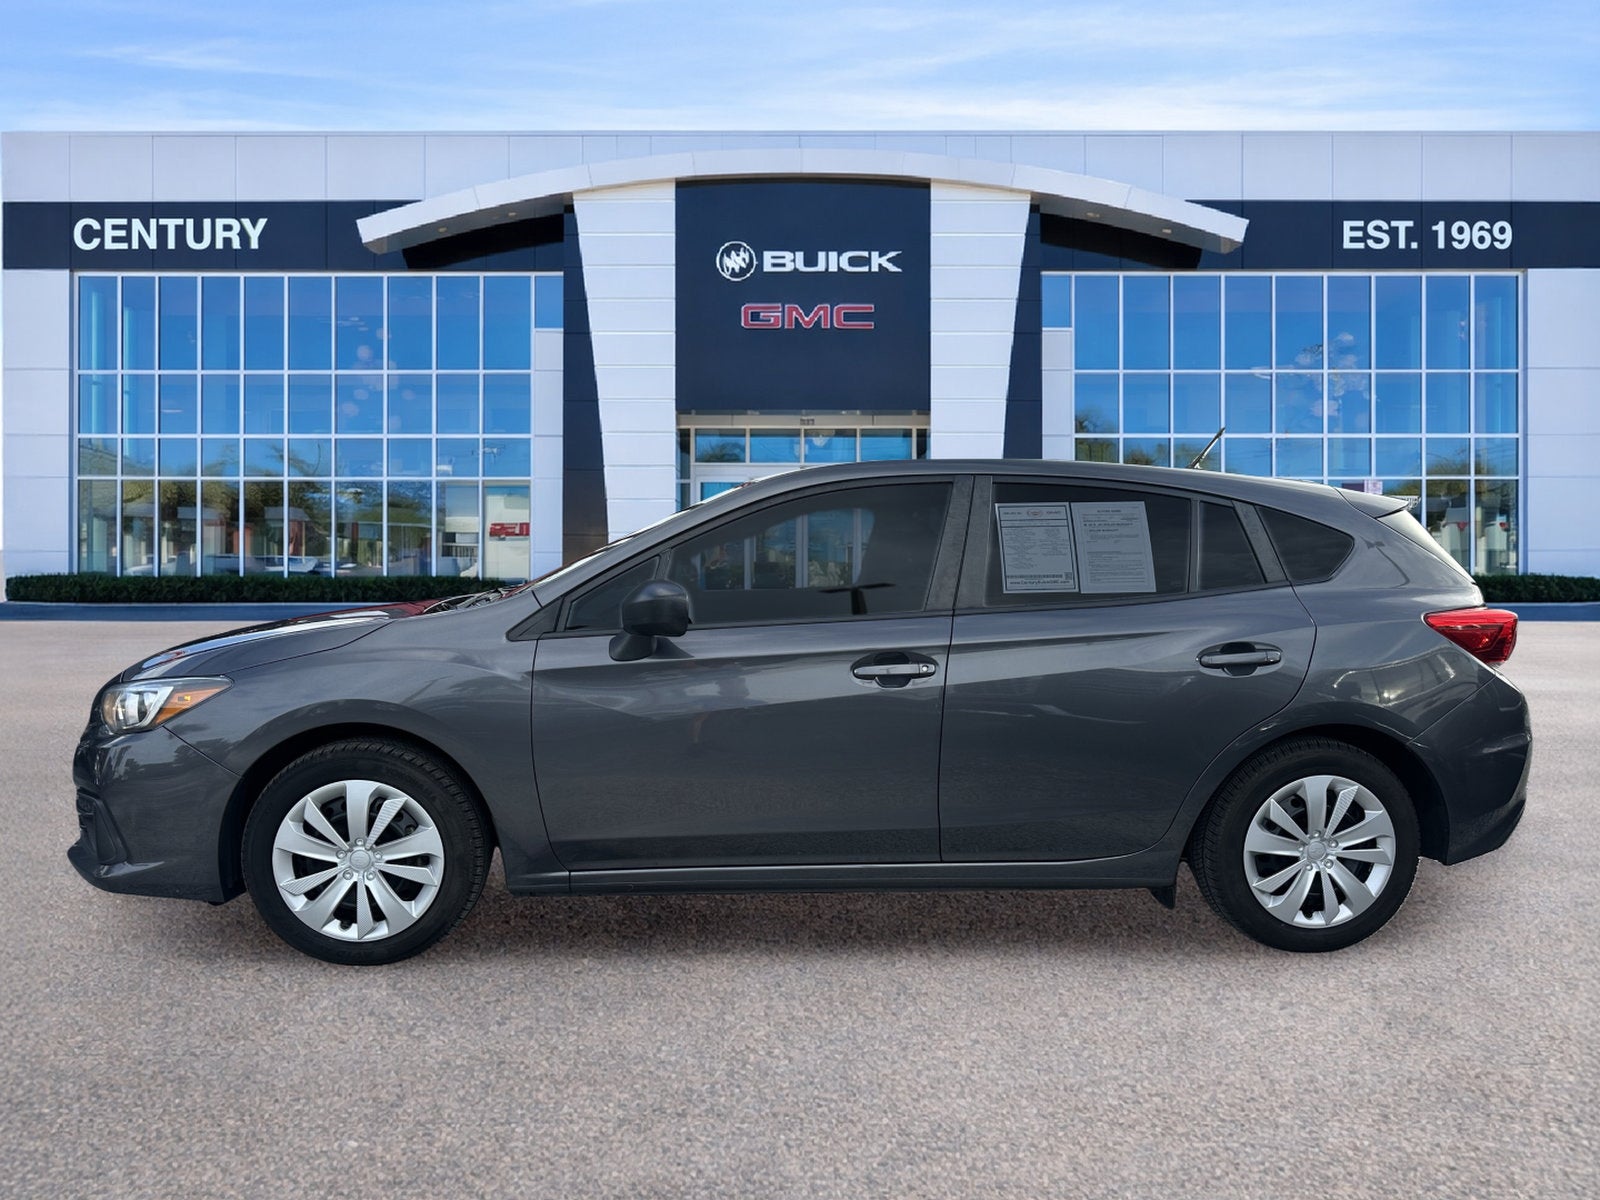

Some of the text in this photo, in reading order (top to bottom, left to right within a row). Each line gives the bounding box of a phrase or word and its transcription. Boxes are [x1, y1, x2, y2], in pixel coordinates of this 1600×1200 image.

[73, 217, 268, 250] CENTURY
[1342, 219, 1513, 250] EST. 1969
[762, 250, 903, 272] BUICK
[740, 303, 875, 329] GMC
